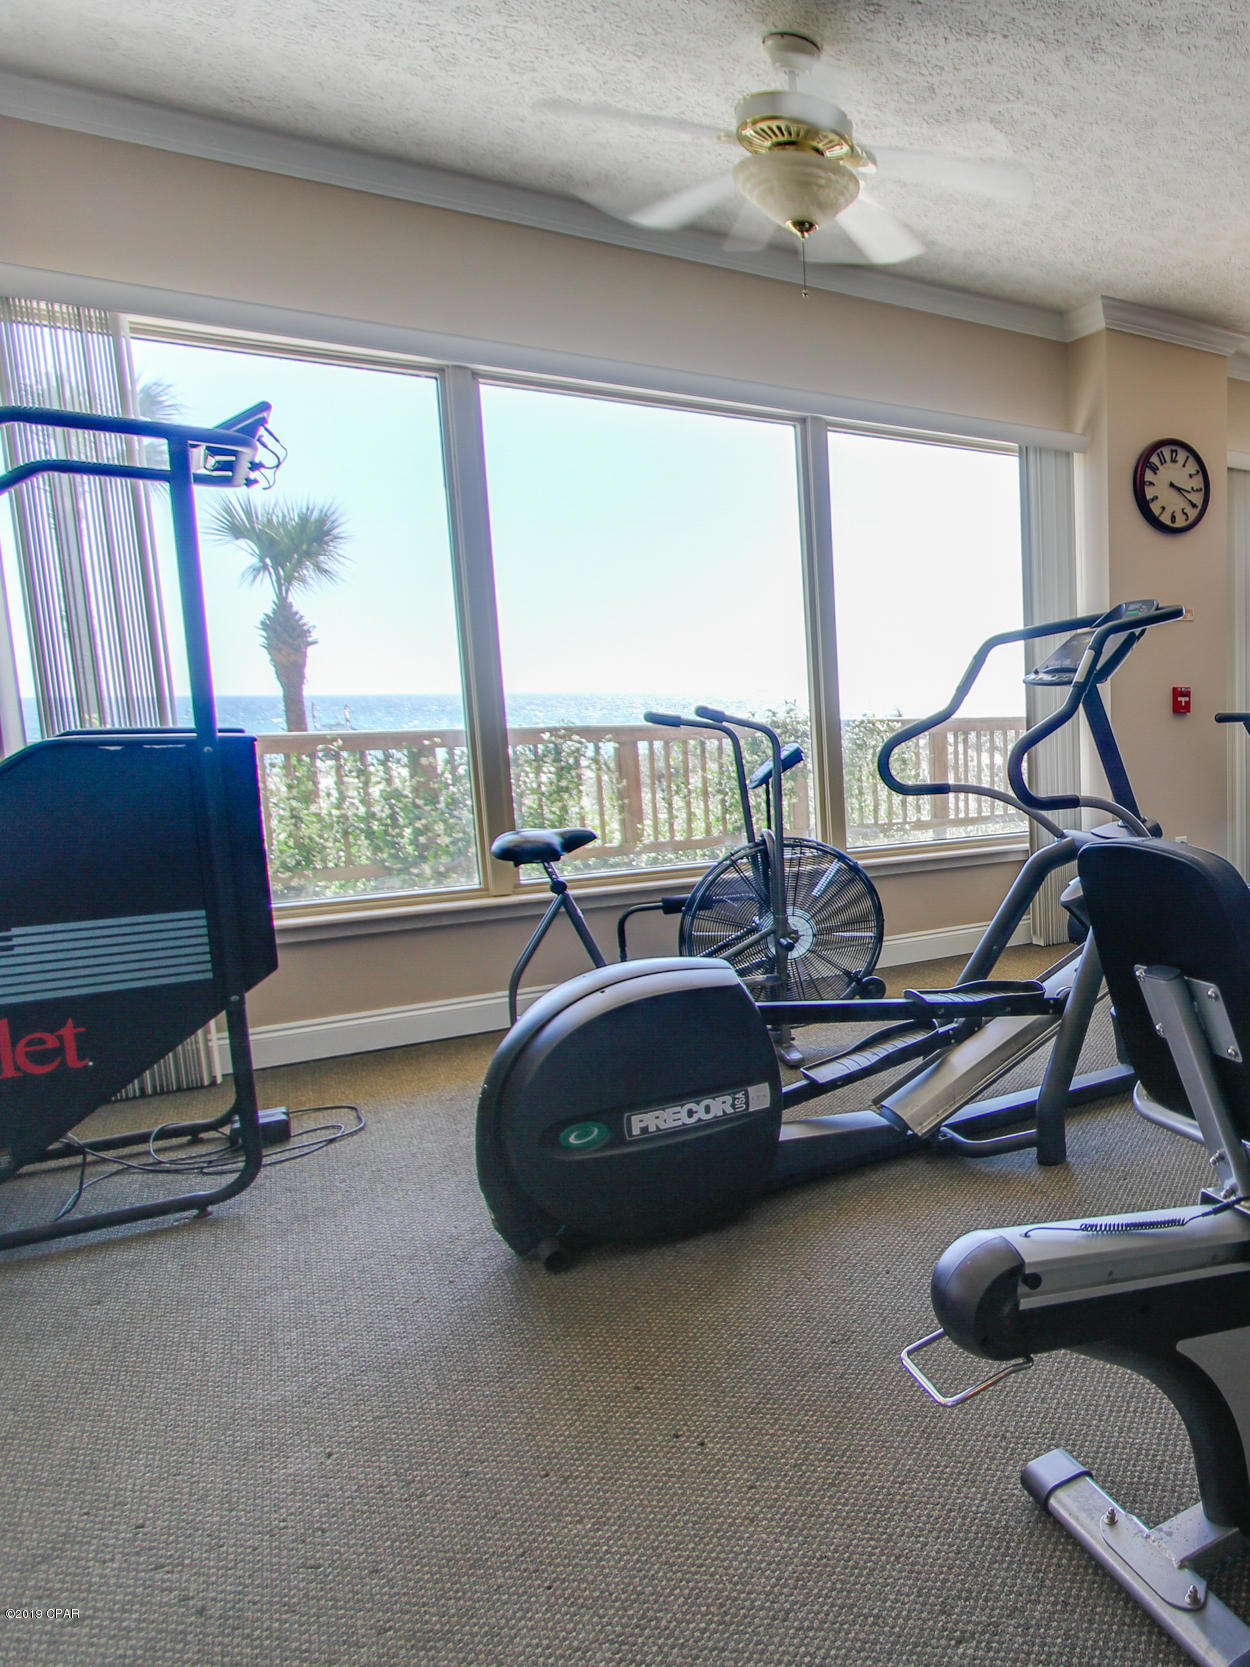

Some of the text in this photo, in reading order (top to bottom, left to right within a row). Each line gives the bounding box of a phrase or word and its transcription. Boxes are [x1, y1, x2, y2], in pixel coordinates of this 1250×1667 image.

[1157, 450, 1167, 466] 11
[1170, 448, 1178, 463] 12
[1182, 455, 1190, 468] 1
[1146, 461, 1159, 475] 10
[1188, 469, 1200, 479] 2
[1158, 505, 1166, 518] 7
[1171, 510, 1176, 524] 6
[1181, 507, 1189, 522] 5
[631, 1091, 746, 1136] PRECOR USA
